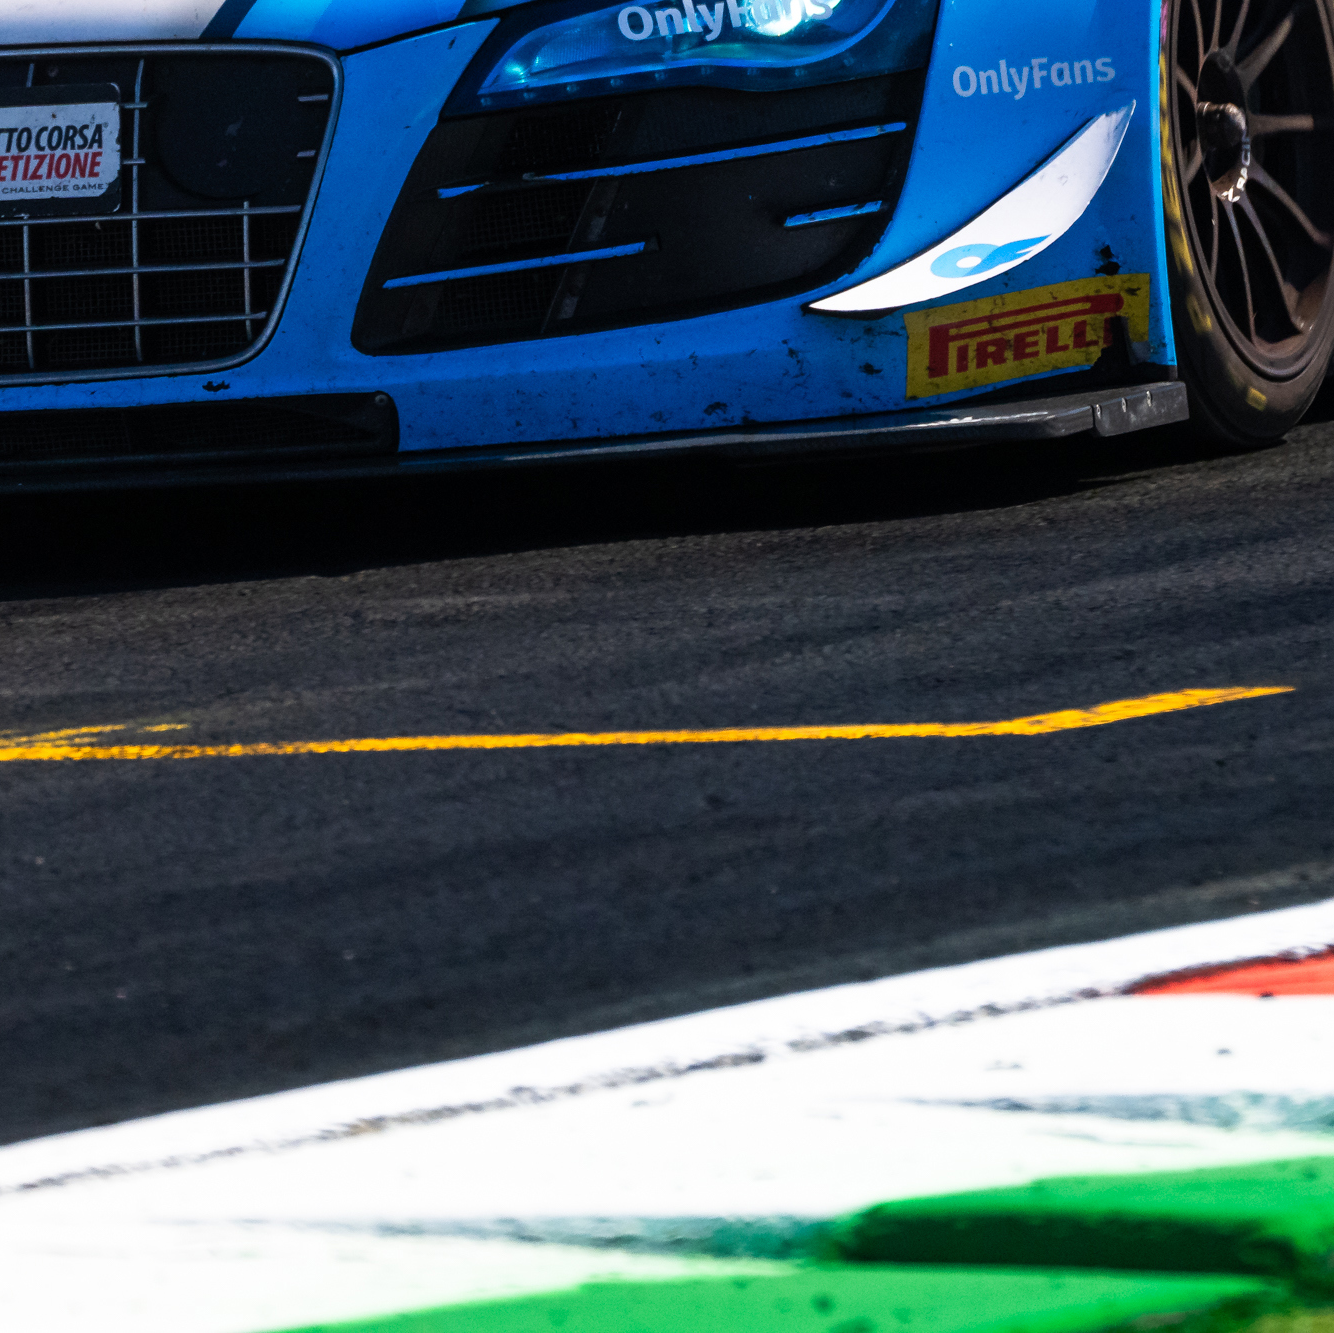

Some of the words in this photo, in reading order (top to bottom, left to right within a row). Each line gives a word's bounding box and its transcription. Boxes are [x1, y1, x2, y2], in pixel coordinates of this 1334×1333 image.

[952, 56, 1116, 101] OnlyFans
[34, 123, 104, 152] CORSA
[1, 184, 69, 195] CHALLENGE
[928, 292, 1125, 380] PIRELLI
